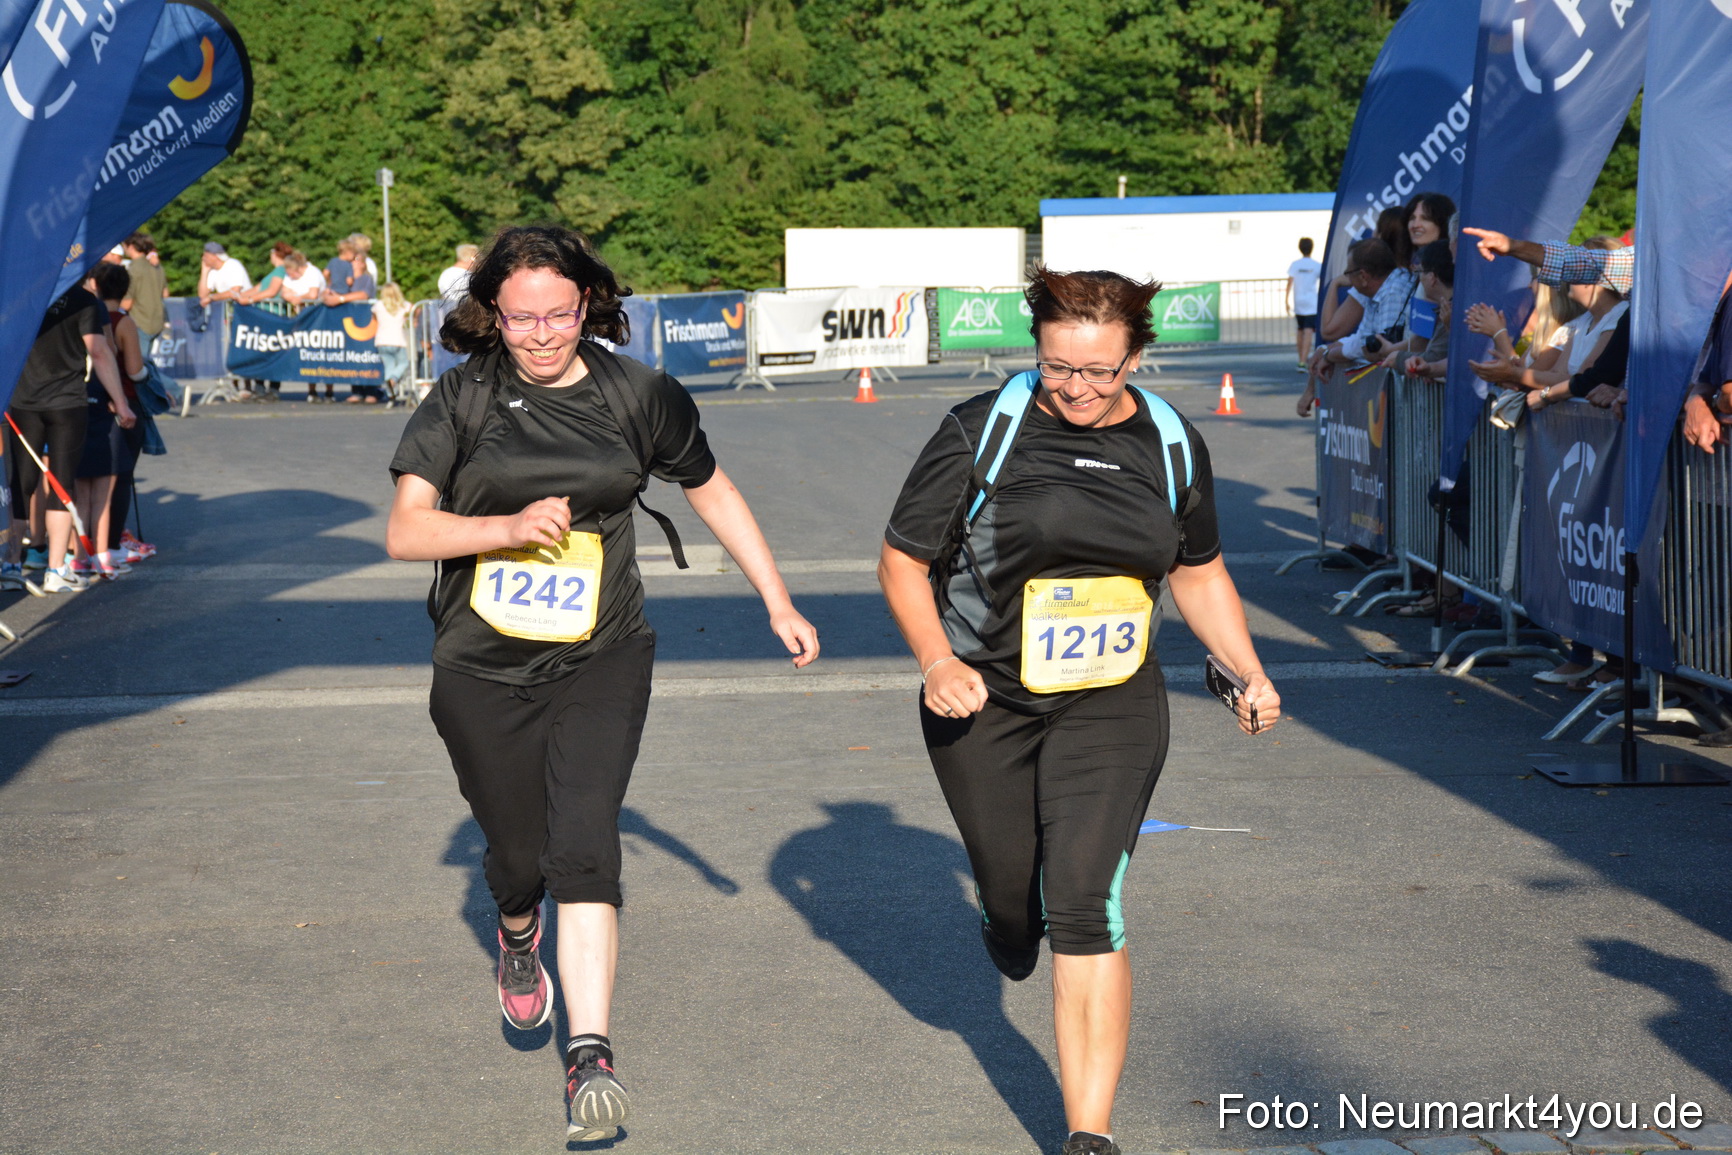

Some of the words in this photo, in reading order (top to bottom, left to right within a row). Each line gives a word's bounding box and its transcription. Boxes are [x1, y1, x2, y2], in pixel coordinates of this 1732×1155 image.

[127, 147, 167, 186] Druck
[191, 91, 238, 140] Medien
[950, 296, 1002, 329] AOK
[1163, 293, 1214, 322] AOK
[235, 324, 345, 352] Frischmann
[664, 318, 729, 343] Frischmann
[299, 349, 326, 362] Druck
[326, 350, 345, 363] und
[1559, 502, 1625, 577] Fische
[488, 567, 586, 612] 1242
[1044, 597, 1090, 608] firmenlauf
[504, 612, 538, 624] Rebecca
[538, 617, 557, 627] Lang
[1038, 621, 1136, 661] 1213
[1061, 667, 1090, 675] Martina
[1090, 664, 1105, 673] Link
